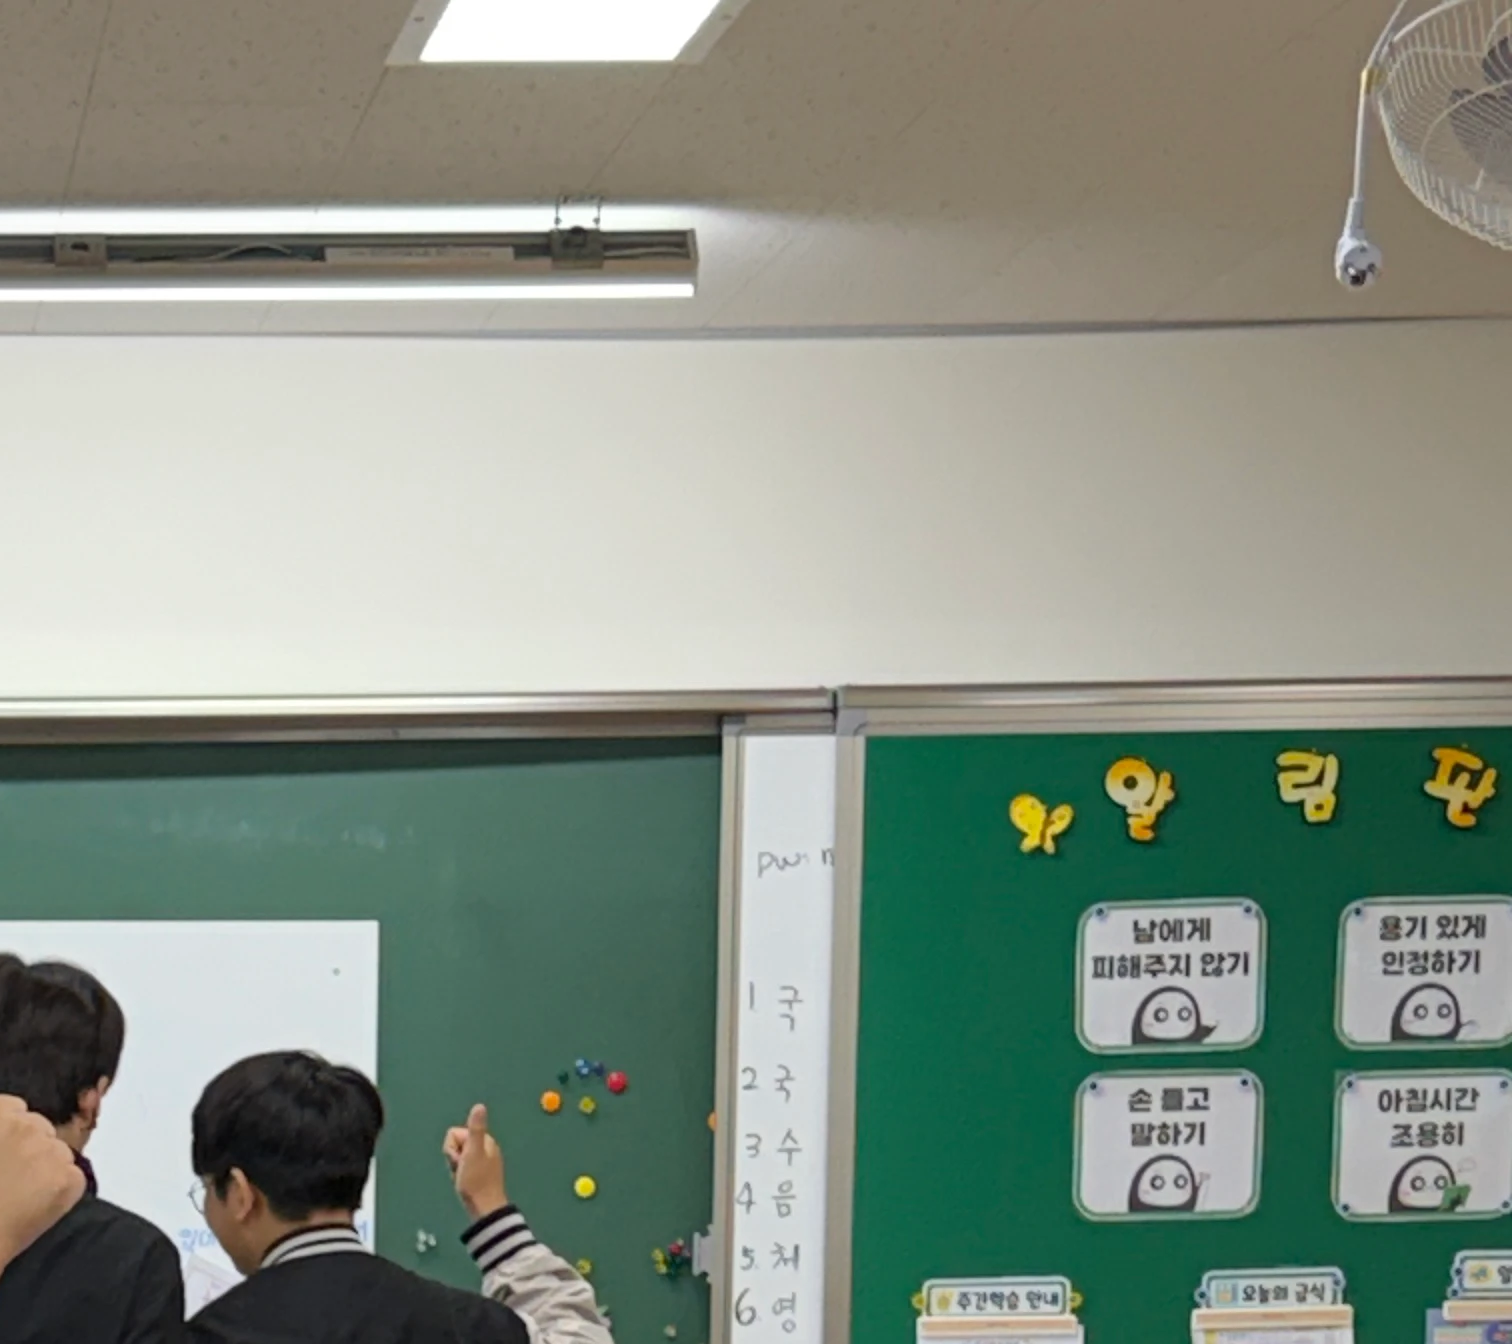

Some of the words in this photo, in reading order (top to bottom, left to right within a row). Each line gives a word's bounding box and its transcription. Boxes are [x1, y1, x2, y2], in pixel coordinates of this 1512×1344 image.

[1132, 917, 1211, 944] 남에게
[1379, 914, 1428, 941] 용기
[1436, 914, 1487, 940] 있게
[1091, 952, 1191, 980] 피해주지
[1200, 951, 1249, 977] 않기
[1381, 949, 1481, 976] 인정하기
[741, 1065, 759, 1091] 2
[1128, 1088, 1152, 1112] 손
[1378, 1087, 1480, 1113] 아침시간
[745, 1133, 761, 1158] 3
[776, 1128, 802, 1166] 수
[1131, 1121, 1206, 1147] 말하기
[1390, 1121, 1465, 1148] 조용히
[734, 1287, 757, 1327] 6
